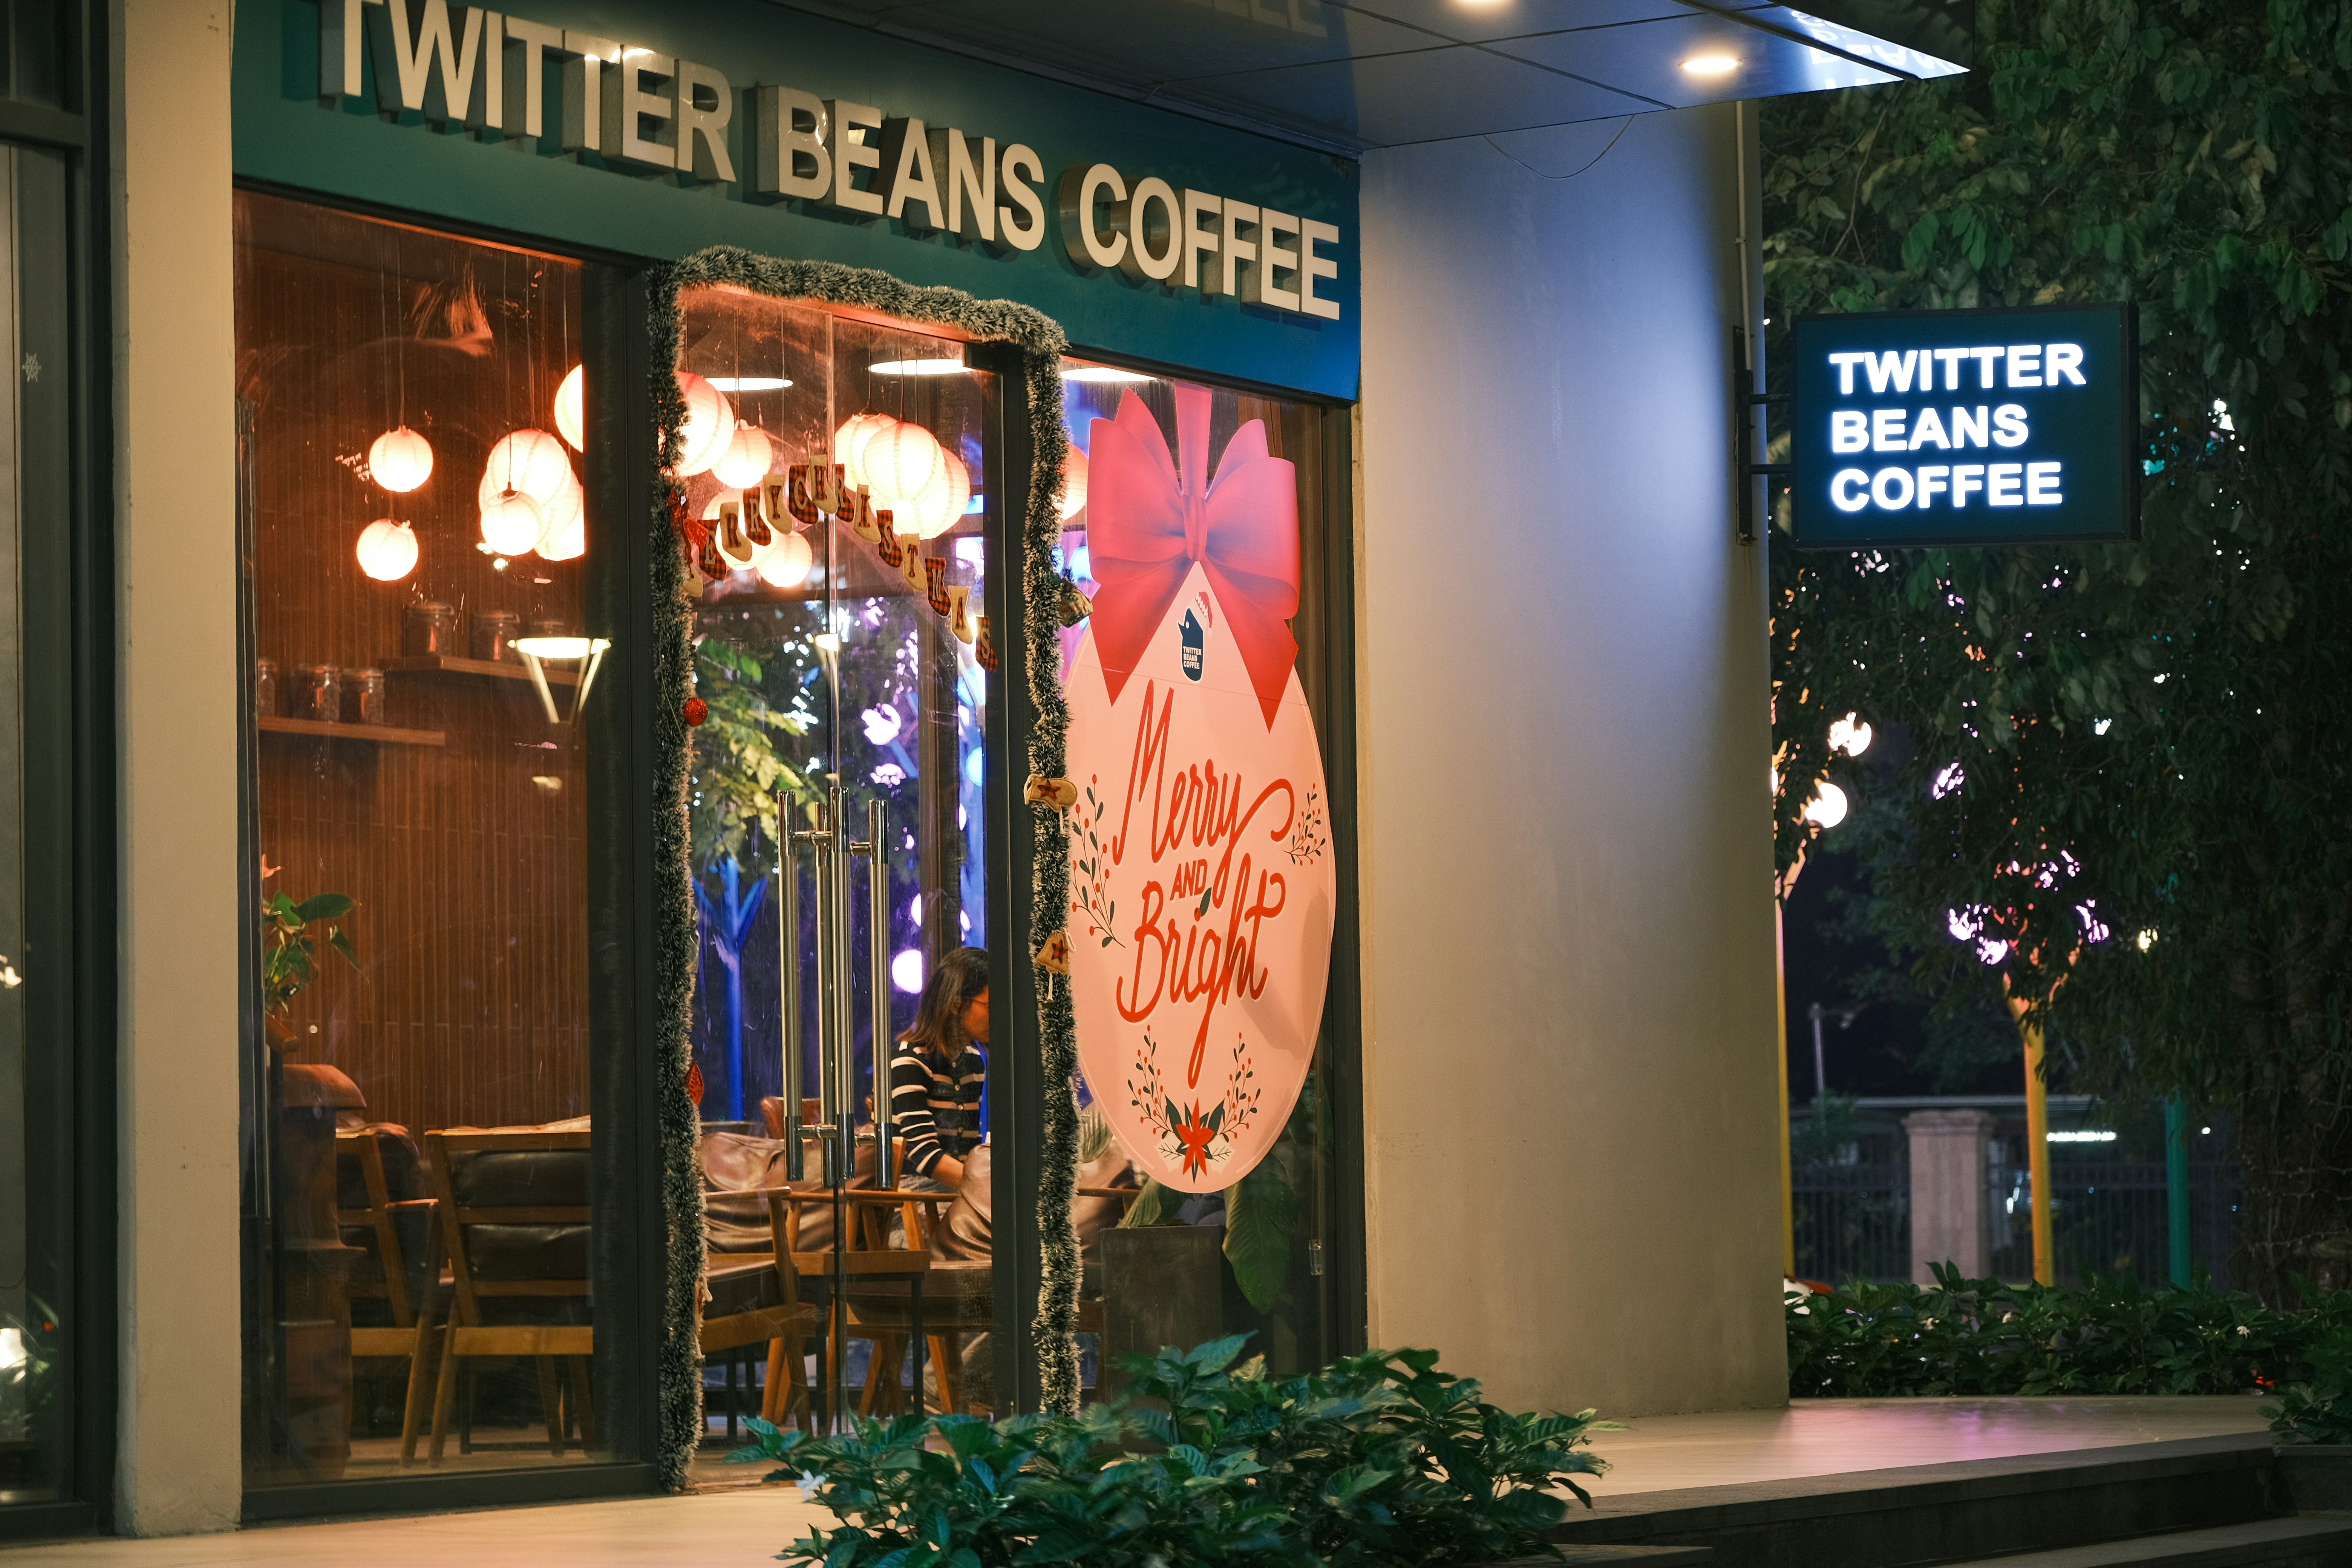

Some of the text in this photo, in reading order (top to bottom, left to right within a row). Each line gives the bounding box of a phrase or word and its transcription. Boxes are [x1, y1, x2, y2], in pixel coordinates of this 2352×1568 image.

[343, 0, 1340, 320] TWITTER BEANS COFFEE
[1829, 343, 2087, 394] TWITTER
[1832, 403, 2029, 453] BEANS
[1830, 461, 2063, 511] COFFEE
[1183, 646, 1202, 655] TWITTER
[1183, 653, 1197, 662] BEANS
[1184, 660, 1200, 669] COFFEE
[1112, 679, 1295, 910] Merry
[1171, 859, 1208, 900] AND
[1116, 852, 1286, 1089] Bright
